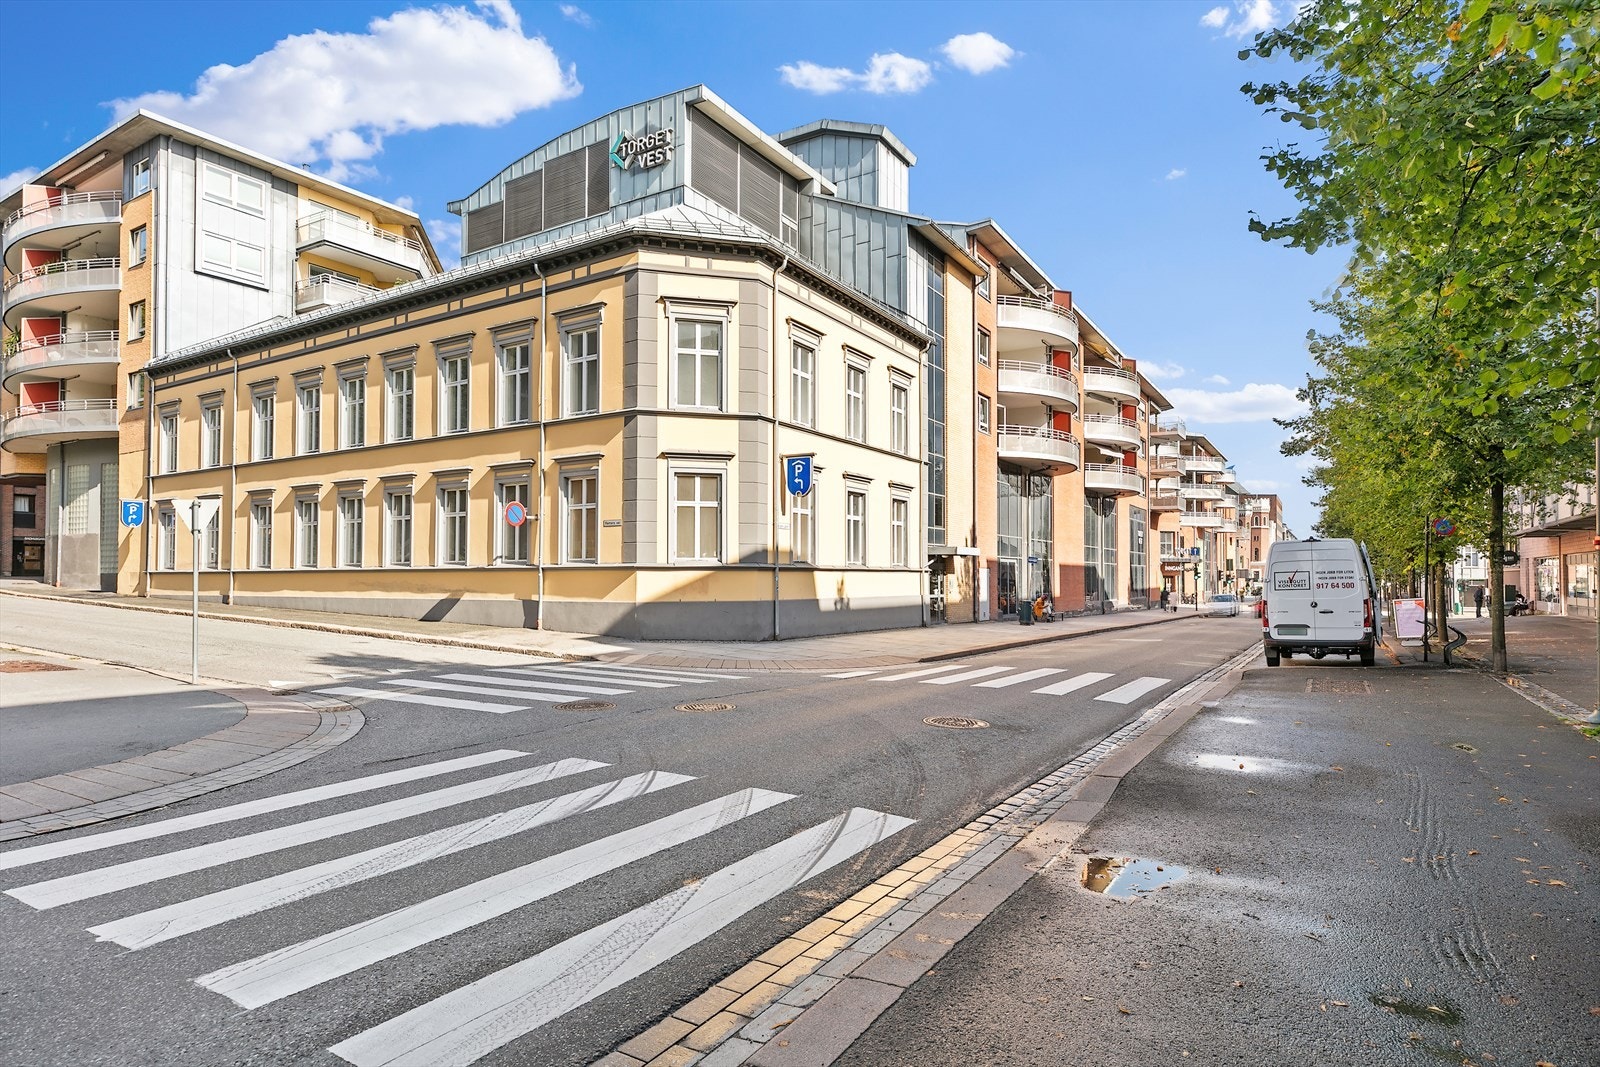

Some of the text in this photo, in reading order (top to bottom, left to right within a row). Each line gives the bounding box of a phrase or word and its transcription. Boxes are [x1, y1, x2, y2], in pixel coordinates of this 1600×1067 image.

[620, 127, 674, 157] TORGET
[637, 145, 675, 168] VEST
[795, 464, 803, 477] P
[129, 506, 137, 514] P
